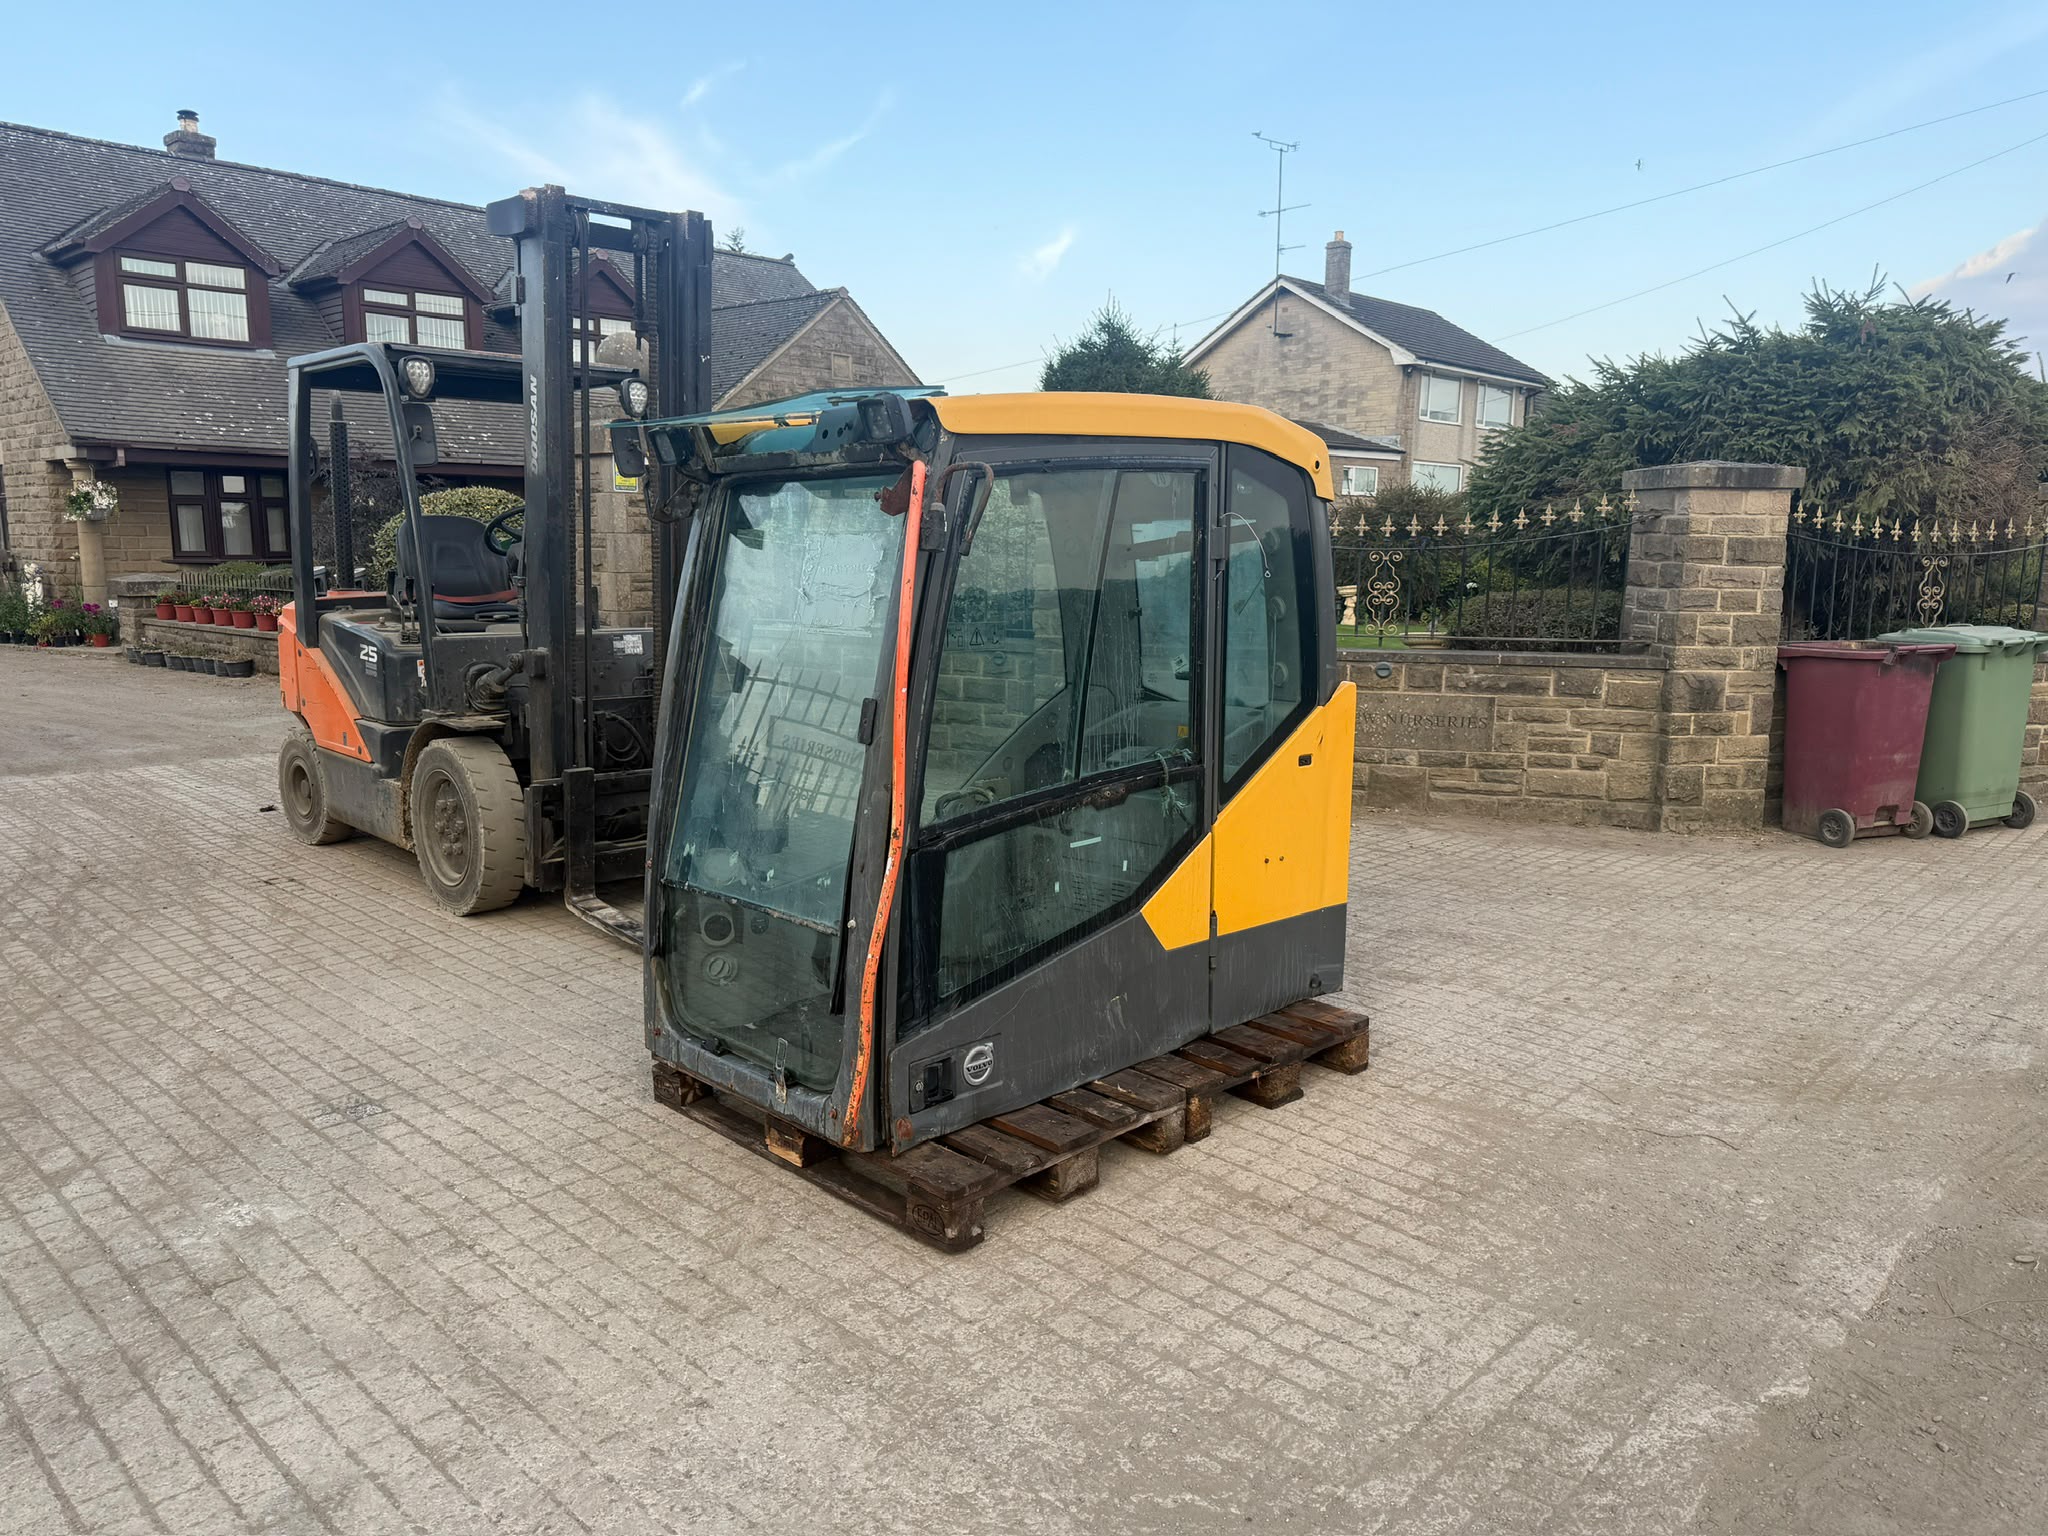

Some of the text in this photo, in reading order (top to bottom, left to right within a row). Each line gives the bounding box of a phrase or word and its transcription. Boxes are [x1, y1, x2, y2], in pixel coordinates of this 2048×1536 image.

[530, 374, 538, 476] DOOSAN
[359, 643, 378, 663] 25
[1386, 712, 1488, 729] NURSERIES
[966, 1060, 993, 1073] VOLVO
